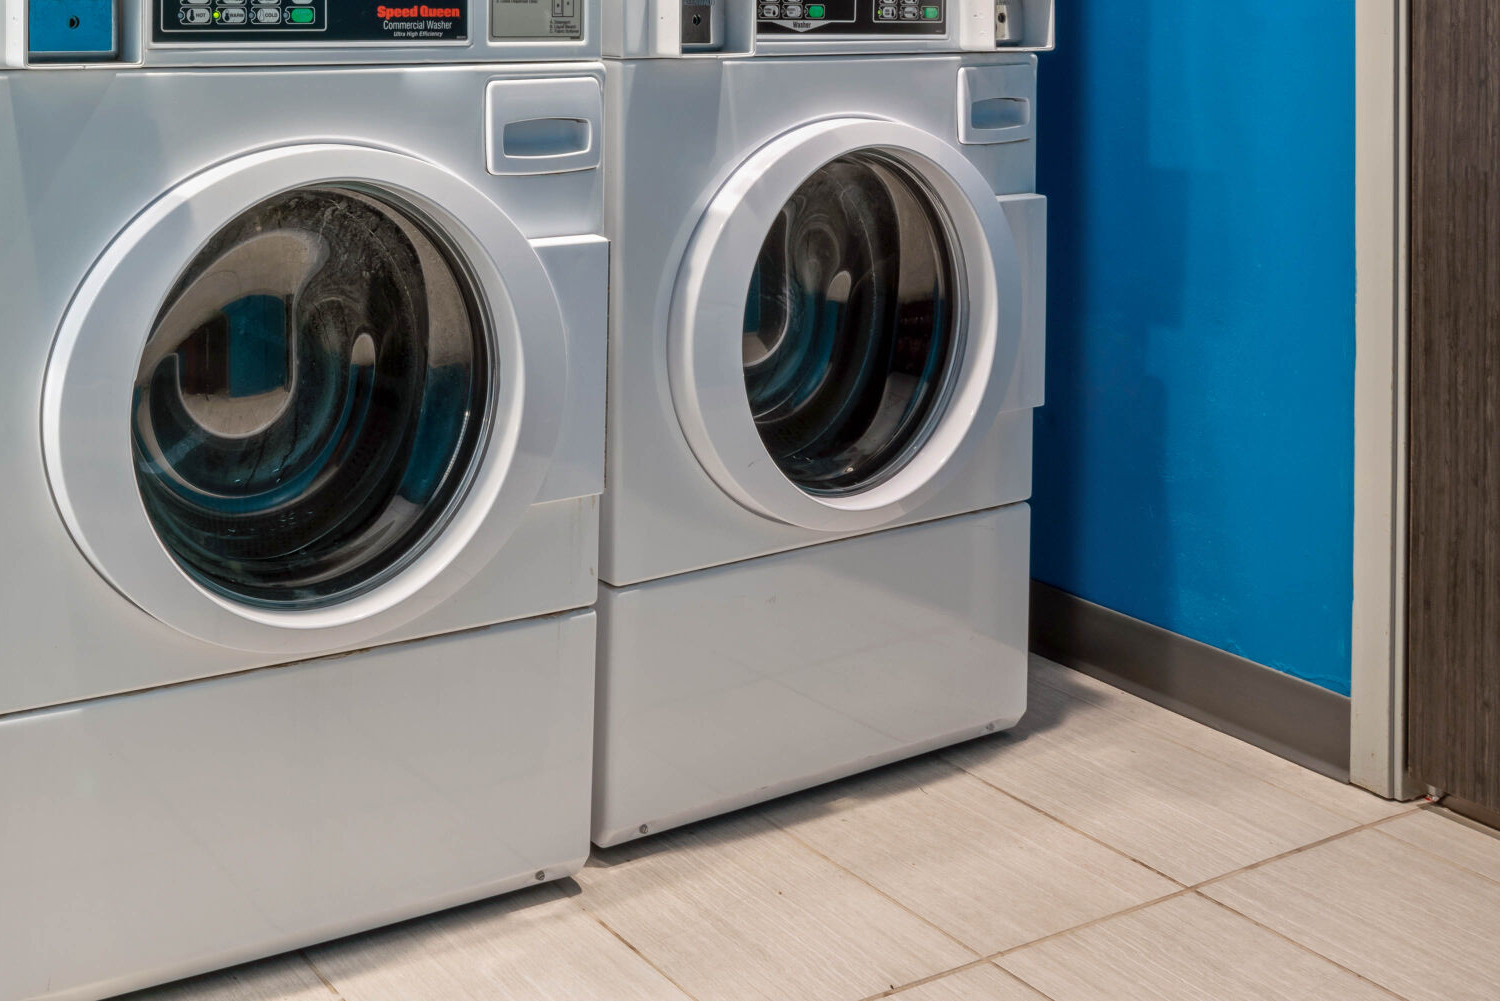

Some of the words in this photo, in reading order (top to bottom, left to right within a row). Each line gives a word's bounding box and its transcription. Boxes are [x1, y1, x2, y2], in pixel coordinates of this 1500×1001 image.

[377, 5, 418, 20] Speed
[420, 5, 460, 18] Queen
[383, 20, 425, 30] Commercial
[426, 20, 452, 30] Washer
[792, 21, 812, 29] Washer
